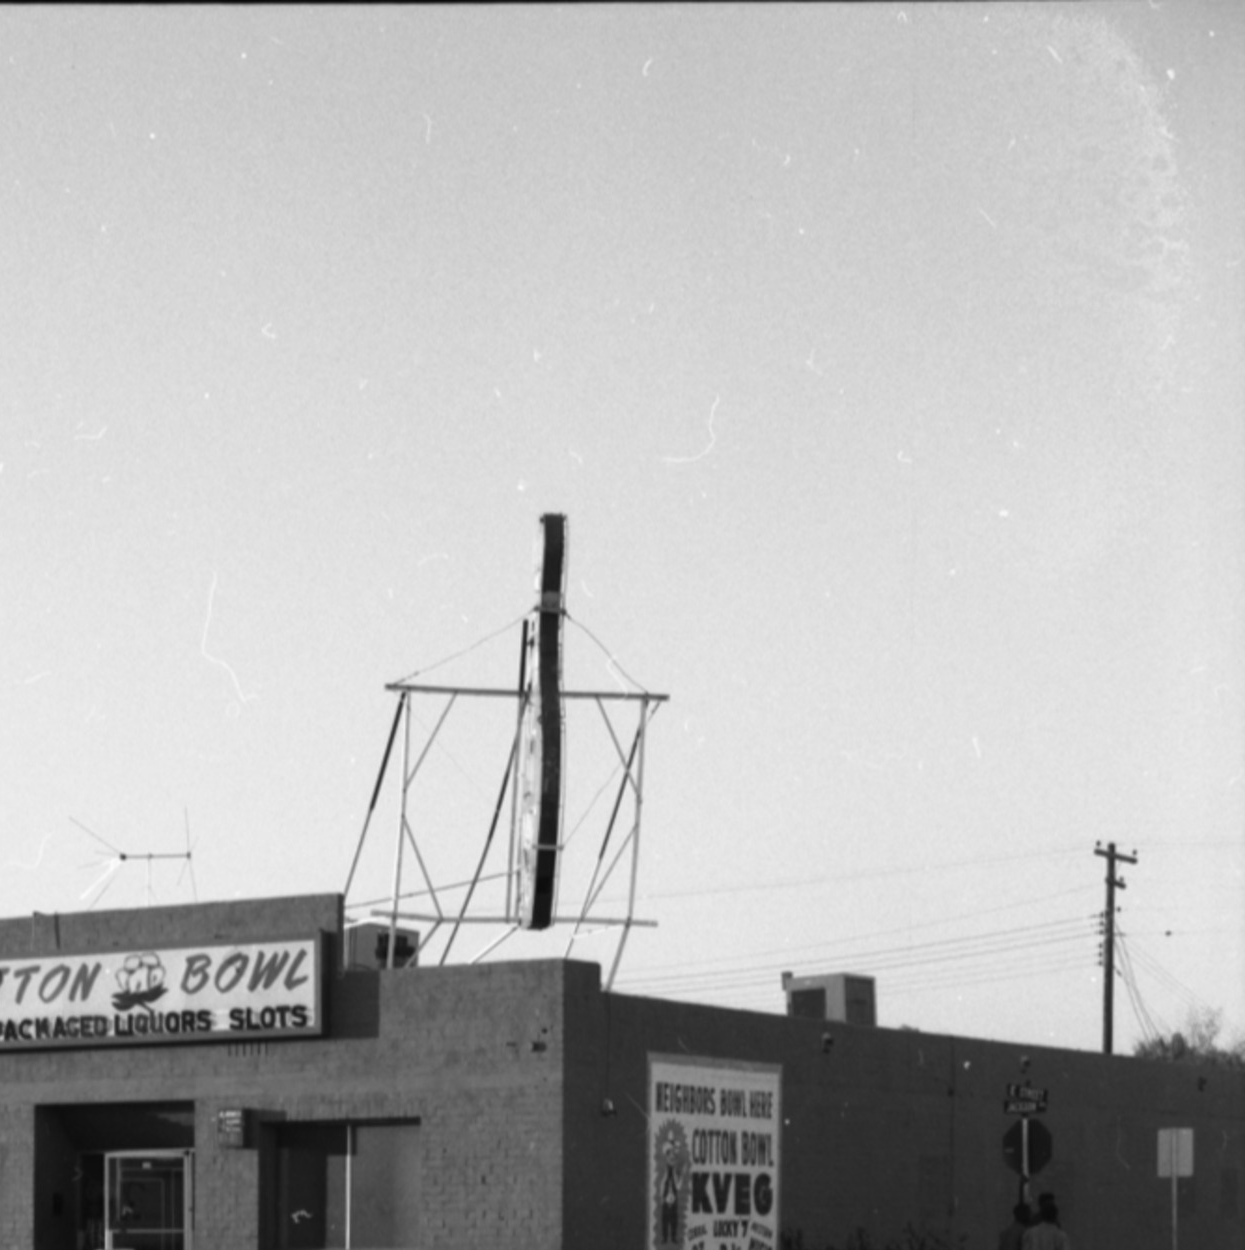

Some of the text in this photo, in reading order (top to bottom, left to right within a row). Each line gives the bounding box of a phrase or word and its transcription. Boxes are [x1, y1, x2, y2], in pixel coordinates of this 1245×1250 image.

[180, 949, 309, 995] BOWL
[114, 1009, 212, 1037] LIQUORS
[229, 1005, 308, 1030] SLOTS
[655, 1081, 773, 1120] NEIGHBORS BOWL HERE
[692, 1128, 774, 1167] COTTON BOWL
[691, 1172, 773, 1217] KVEG
[713, 1220, 738, 1238] LUCKY
[741, 1220, 749, 1238] 7
